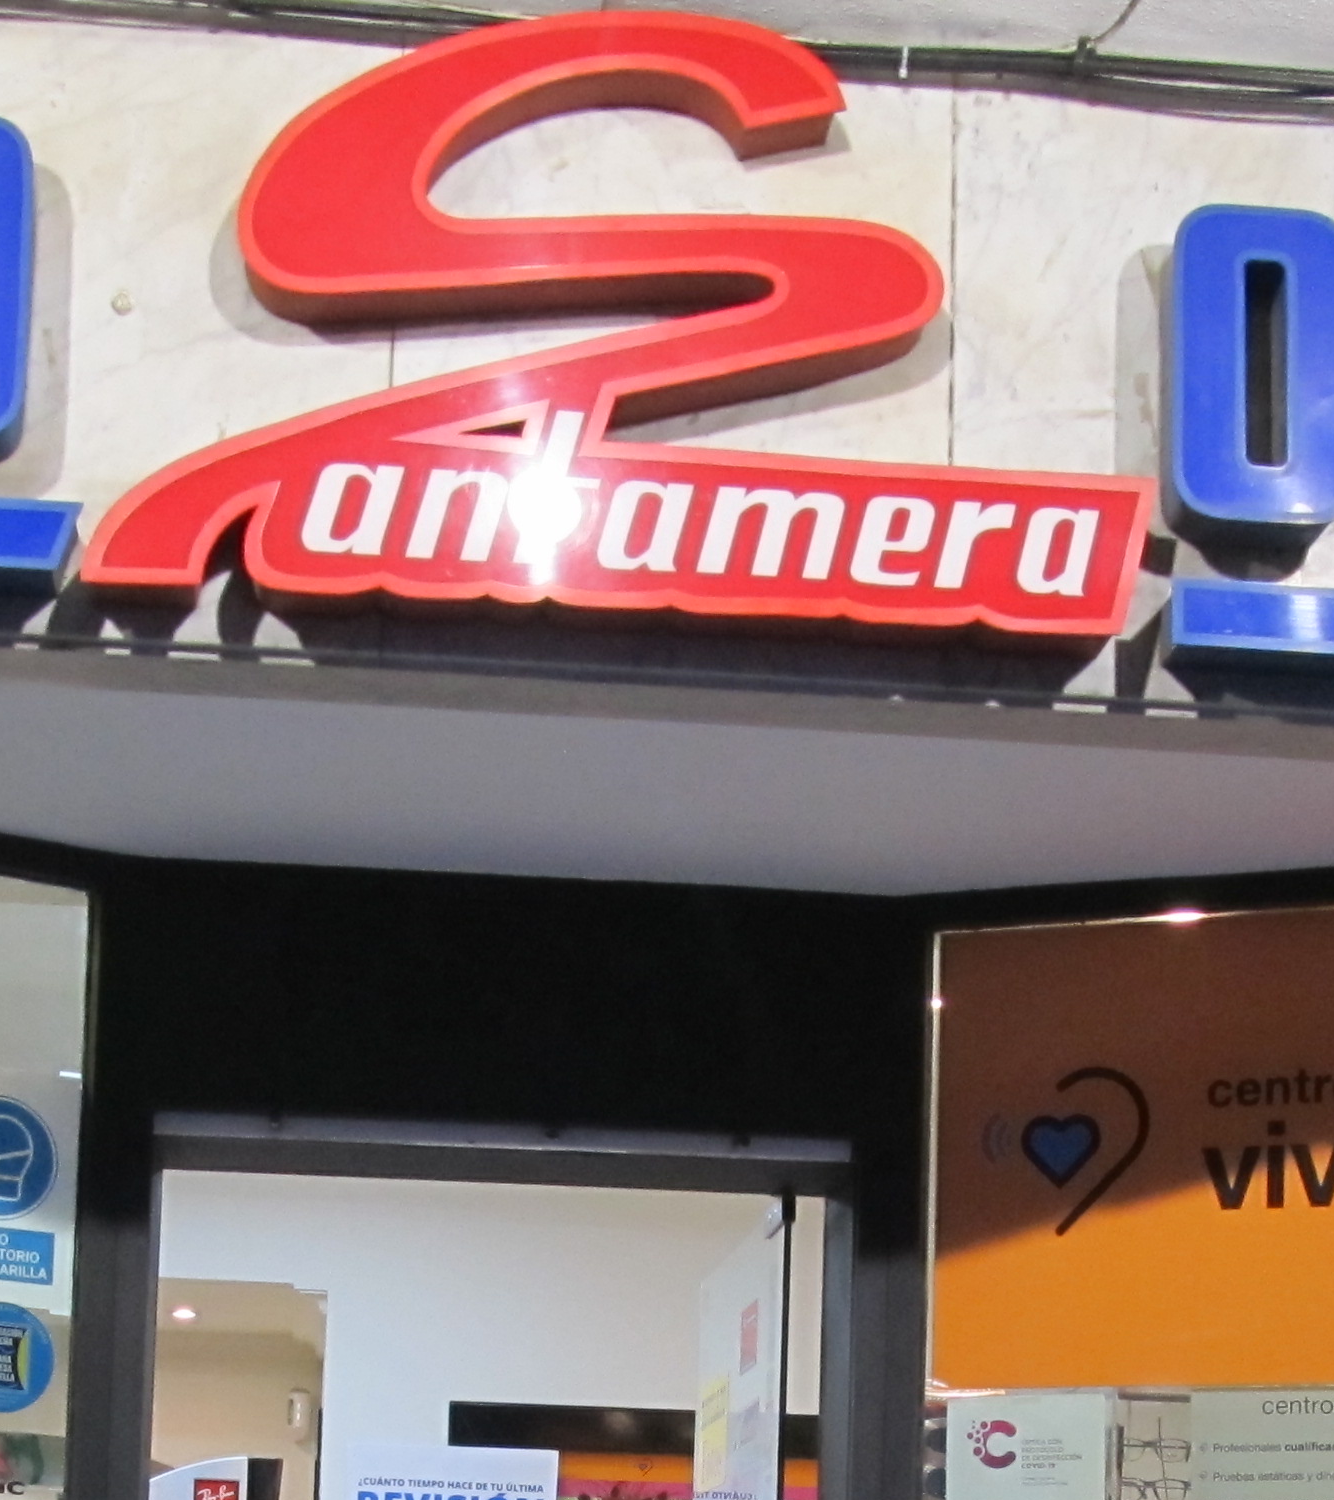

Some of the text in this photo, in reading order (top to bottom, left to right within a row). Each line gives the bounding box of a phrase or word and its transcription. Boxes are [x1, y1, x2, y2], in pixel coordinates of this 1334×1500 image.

[358, 1476, 544, 1493] ¿CUÁNTO TIEMPO HACE DE TU ÚLTIMA
